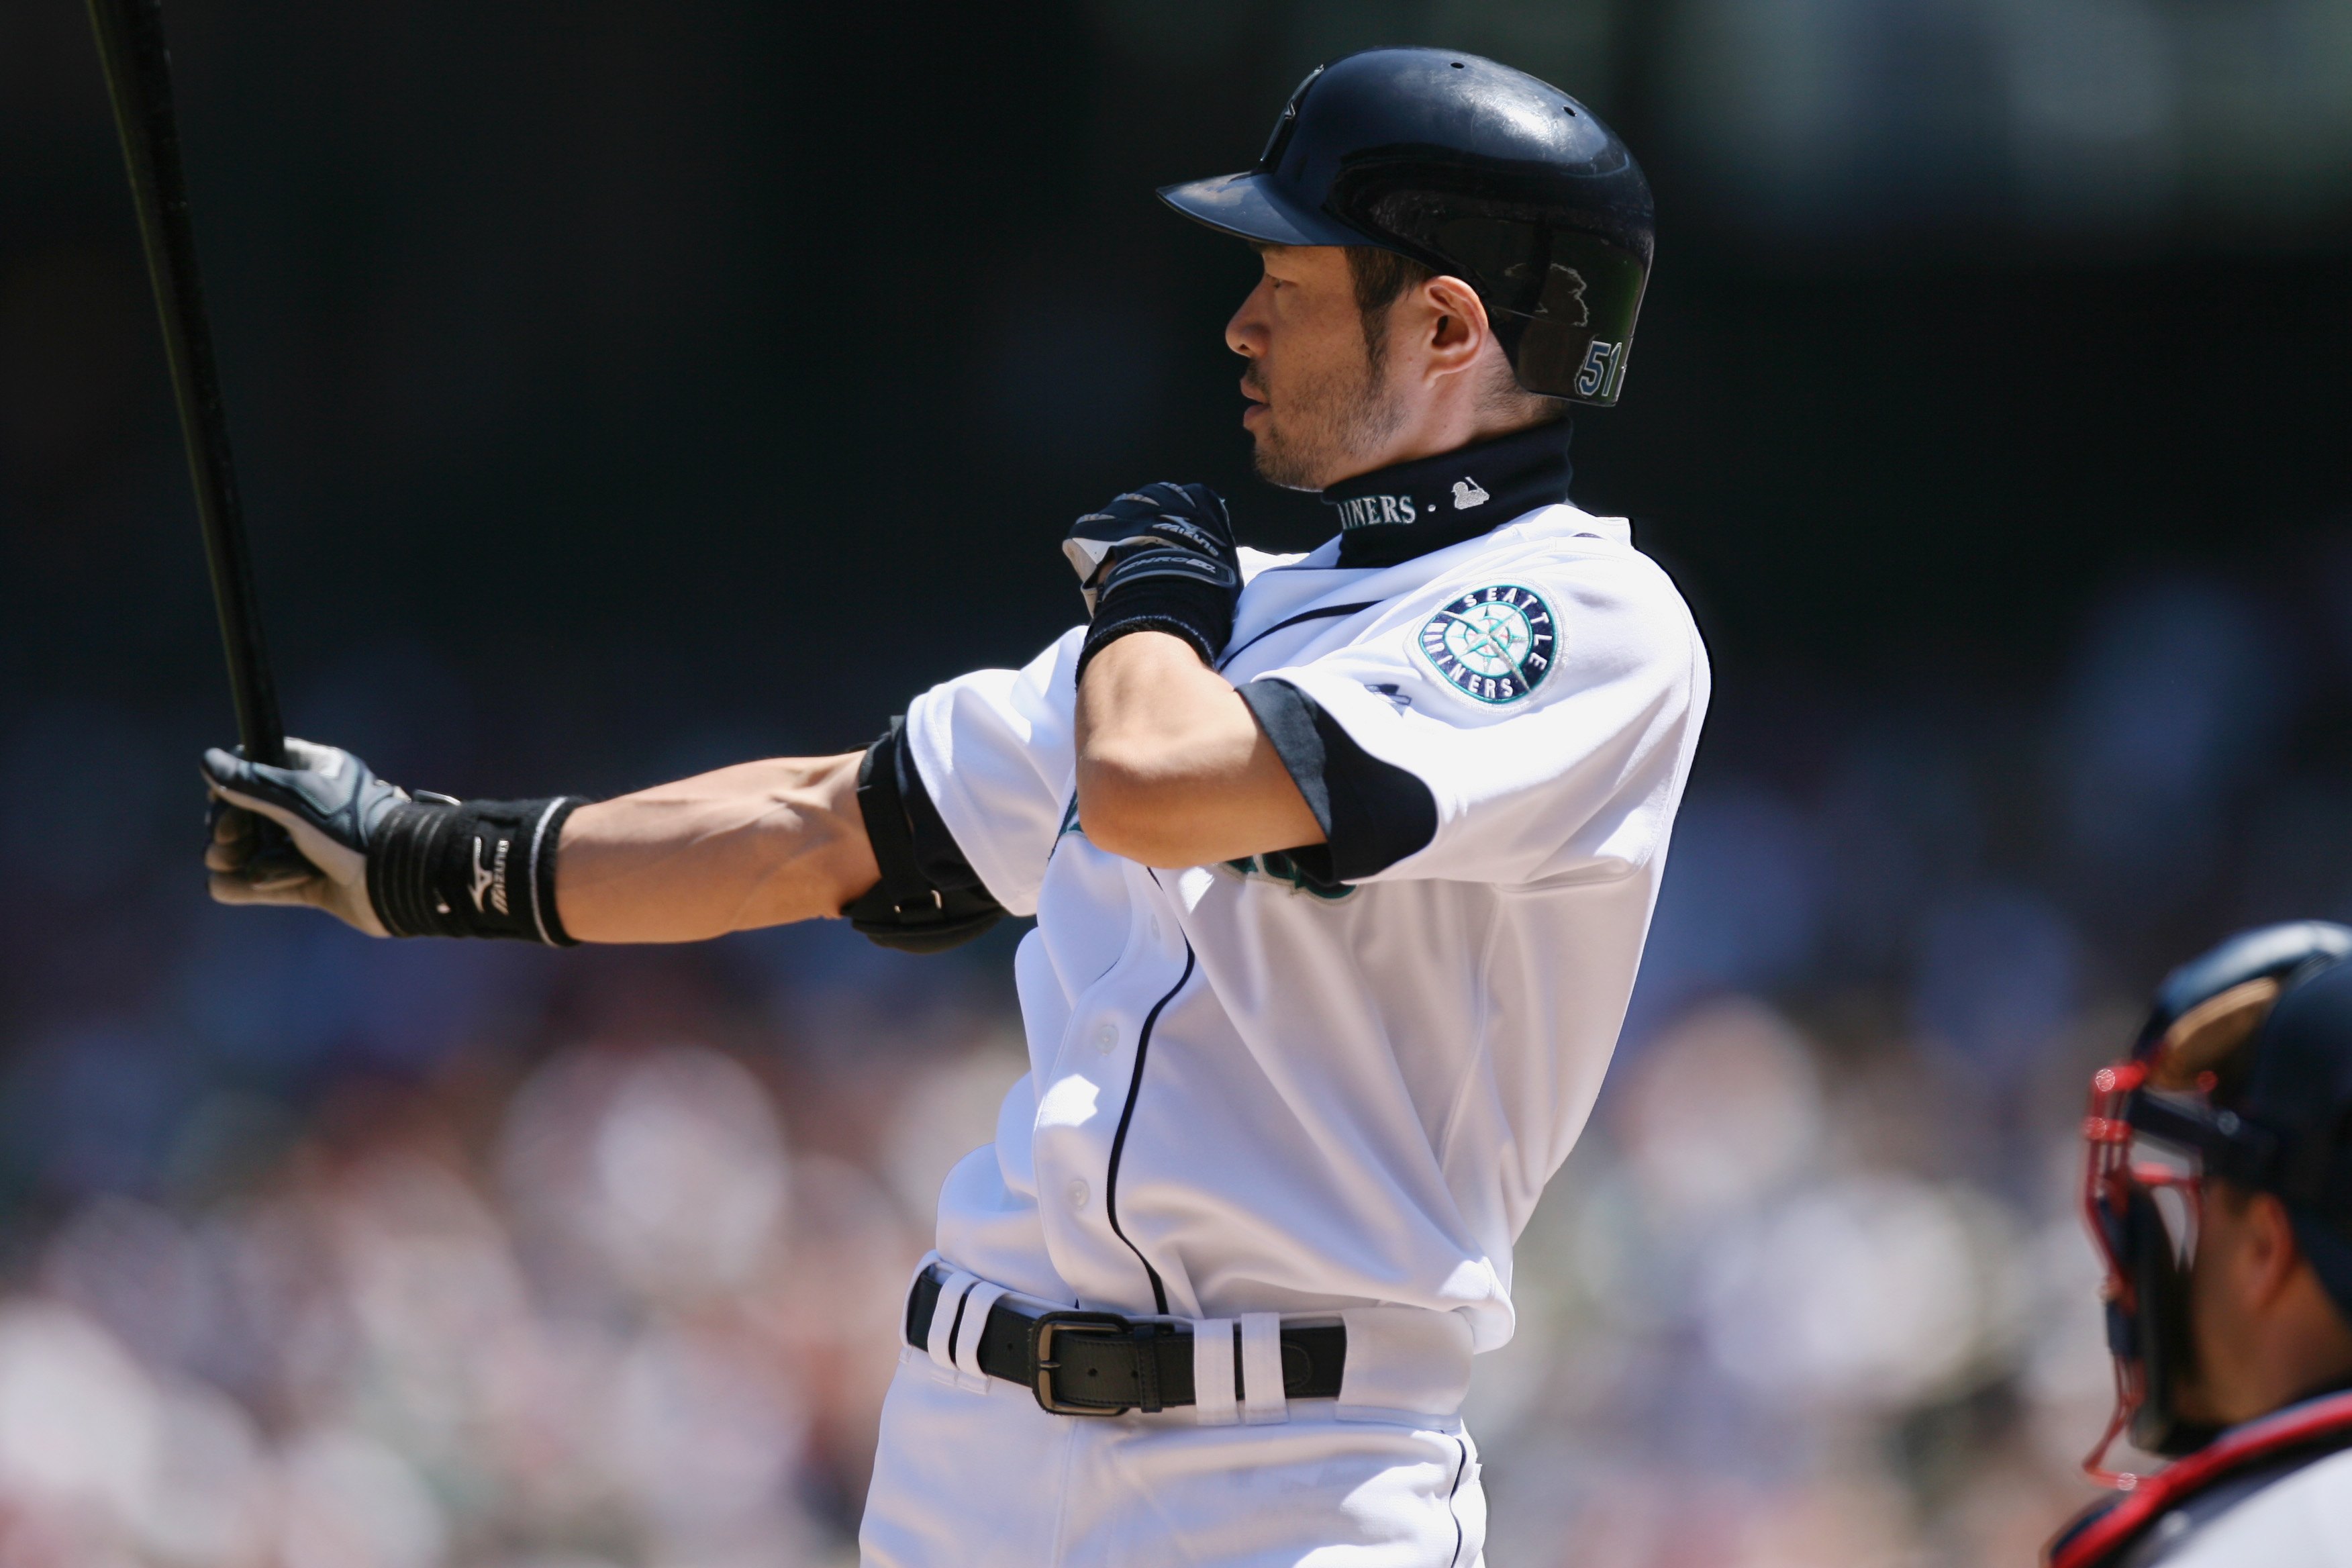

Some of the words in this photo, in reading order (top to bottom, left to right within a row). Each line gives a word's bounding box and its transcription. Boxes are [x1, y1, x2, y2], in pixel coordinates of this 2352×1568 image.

[1579, 340, 1622, 397] 51
[1422, 622, 1514, 699] MARINERS
[1463, 587, 1553, 671] SEATTLE
